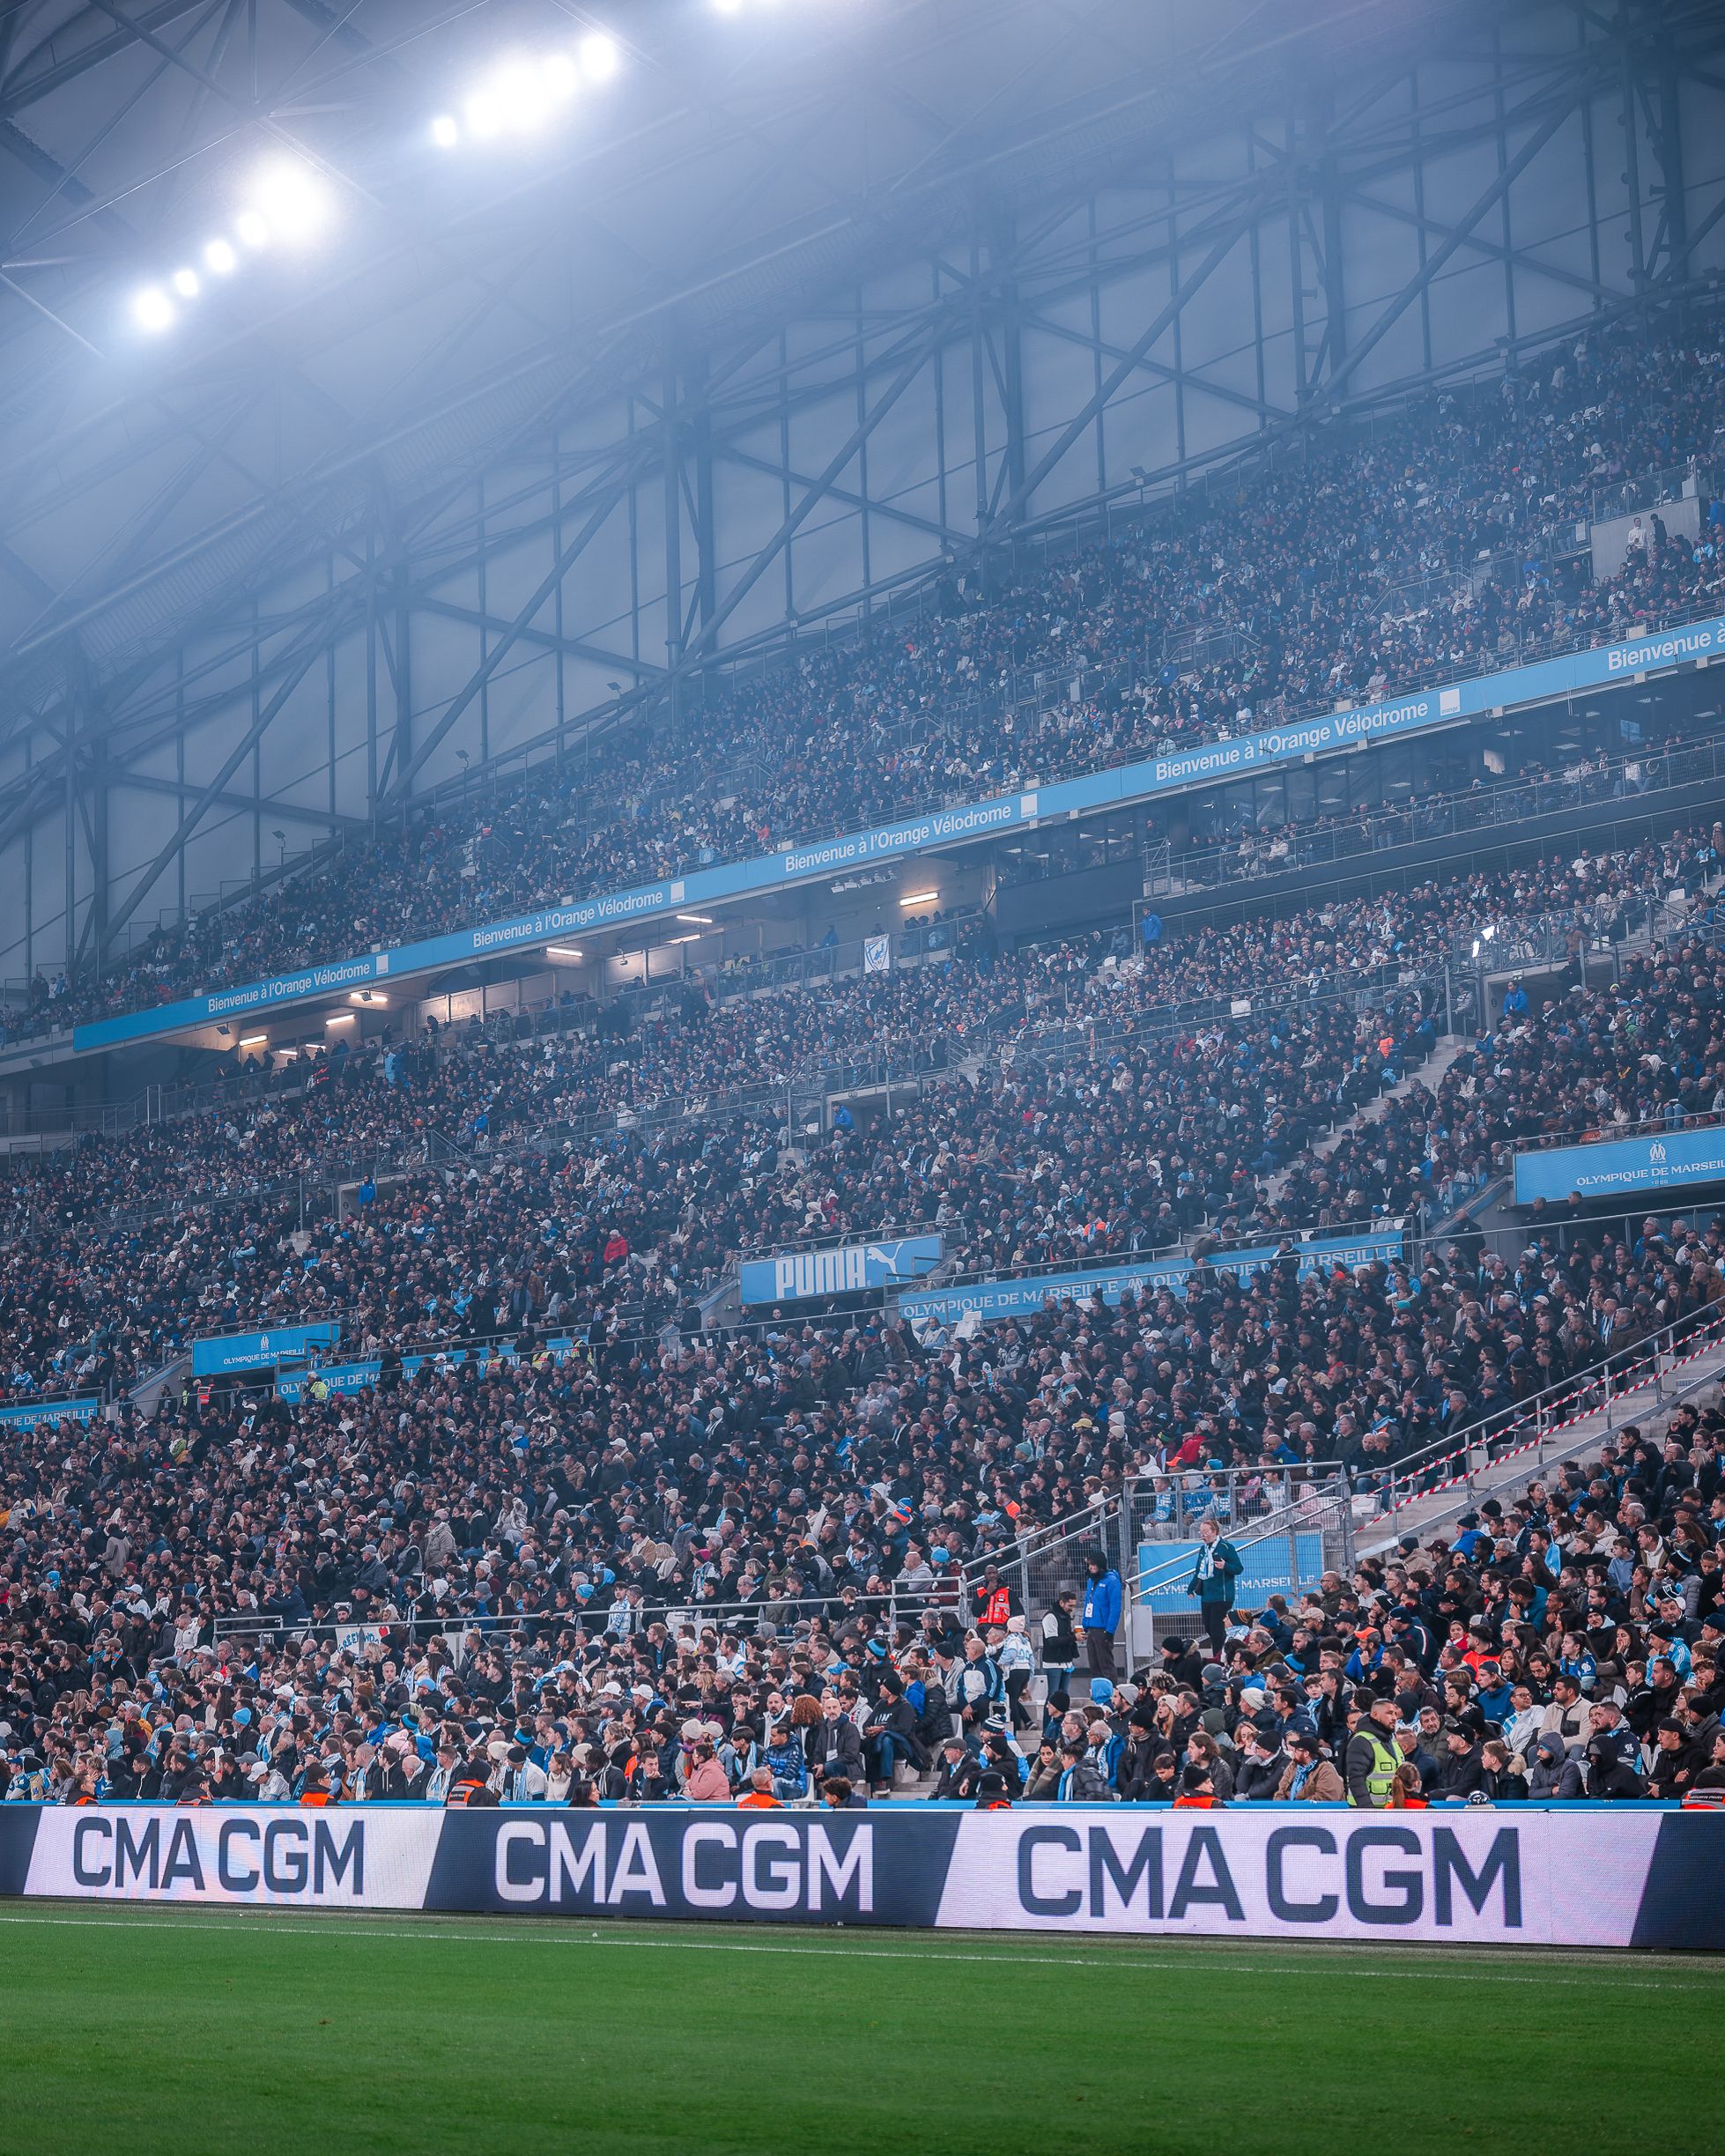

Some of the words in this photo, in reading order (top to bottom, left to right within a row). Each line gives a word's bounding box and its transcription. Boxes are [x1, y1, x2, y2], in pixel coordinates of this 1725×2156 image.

[1608, 632, 1712, 671] Bienvenue
[1156, 747, 1240, 782] Bienvenue
[1244, 741, 1255, 759] à
[1259, 725, 1330, 757] l'Orange
[1334, 700, 1429, 737] Vélodrome
[785, 843, 855, 872] Bienvenue
[859, 838, 867, 854] à
[870, 824, 930, 851] l'Orange
[933, 804, 1011, 835] Vélodrome
[473, 922, 532, 948] Bienvenue
[535, 916, 543, 933] à
[544, 907, 595, 930] l'Orange
[597, 891, 663, 917] Vélodrome
[208, 989, 258, 1013] Bienvenue
[261, 984, 267, 999] à
[269, 976, 312, 997] l'Orange
[314, 962, 370, 986] Vélodrome
[1576, 1169, 1648, 1186] OLYMPIQUE
[1651, 1167, 1669, 1177] DE
[775, 1248, 866, 1300] PUMA
[903, 1295, 995, 1318] OLYMPIQUE
[997, 1293, 1019, 1306] DE
[1023, 1280, 1118, 1302] MARSEILLE
[223, 1354, 260, 1366] OLYMPIQUE
[270, 1347, 305, 1360] MARSEILL
[347, 1374, 363, 1386] DE
[25, 1415, 37, 1426] DE
[1241, 1574, 1315, 1589] MARSEILE
[72, 1816, 205, 1891] CMA
[218, 1818, 364, 1895] CGM
[495, 1820, 667, 1907] CMA
[682, 1821, 874, 1912] CGM
[1018, 1826, 1246, 1922] CMA
[1266, 1826, 1522, 1929] CGM
